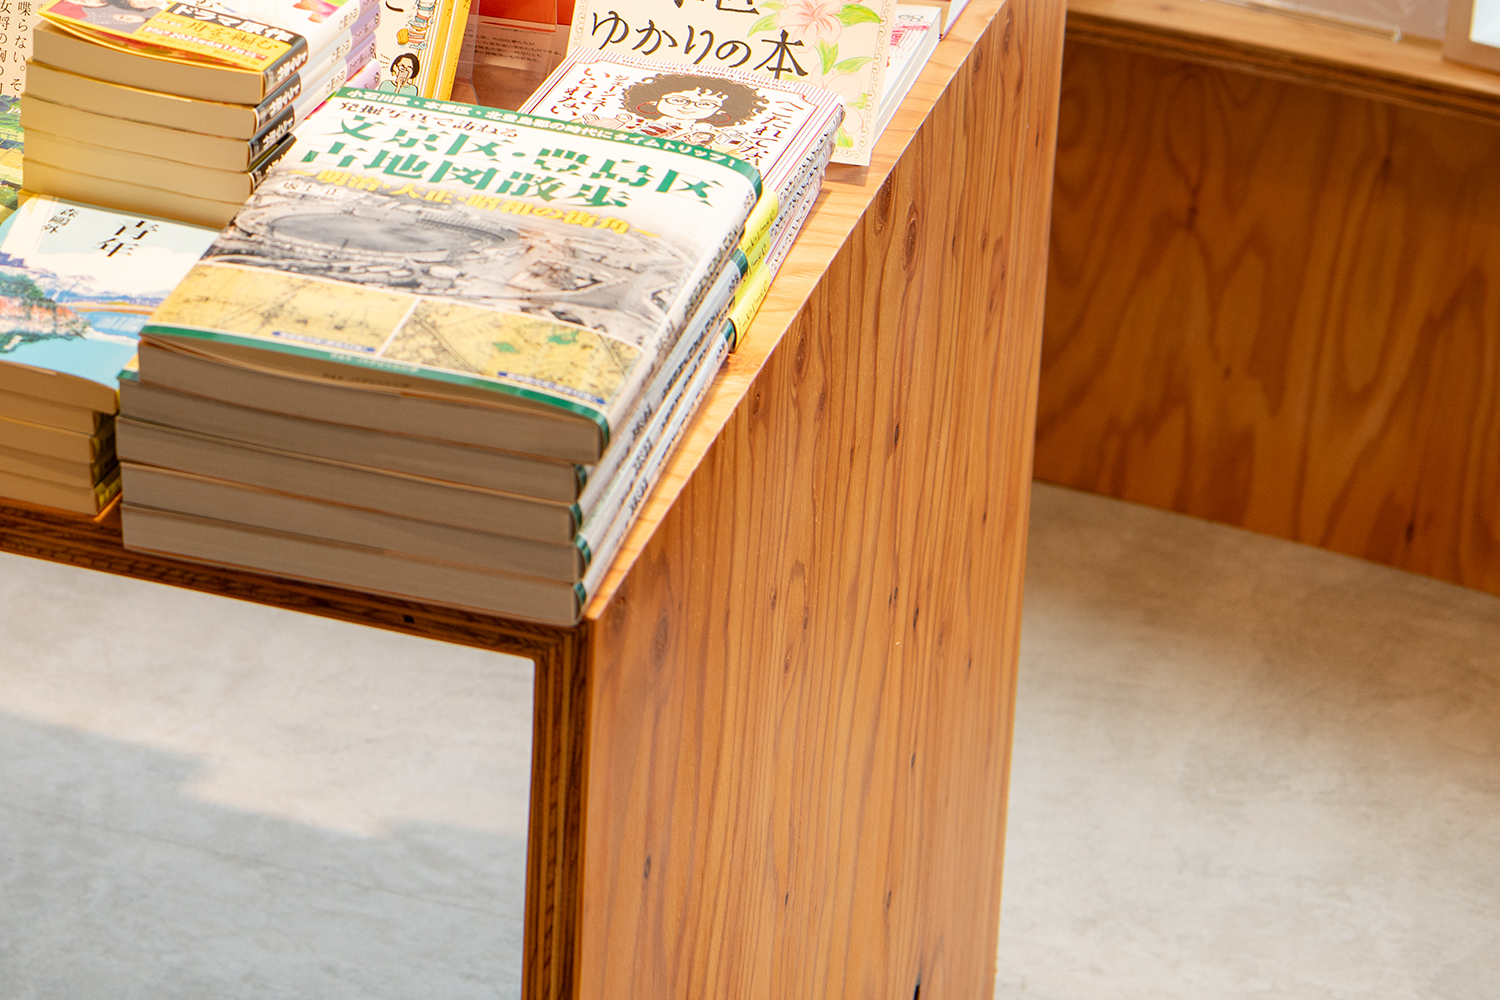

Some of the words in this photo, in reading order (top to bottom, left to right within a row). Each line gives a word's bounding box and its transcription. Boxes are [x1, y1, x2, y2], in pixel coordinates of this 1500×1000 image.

[10, 1, 32, 93] 喋らない。そ
[172, 4, 295, 42] ドラマ原作
[591, 10, 808, 80] ゆかりの本
[337, 101, 518, 139] 発掘写真で訪ねる
[302, 140, 631, 209] 古地図散歩
[331, 115, 726, 206] 文京区・豊島区
[95, 220, 159, 258] 青年
